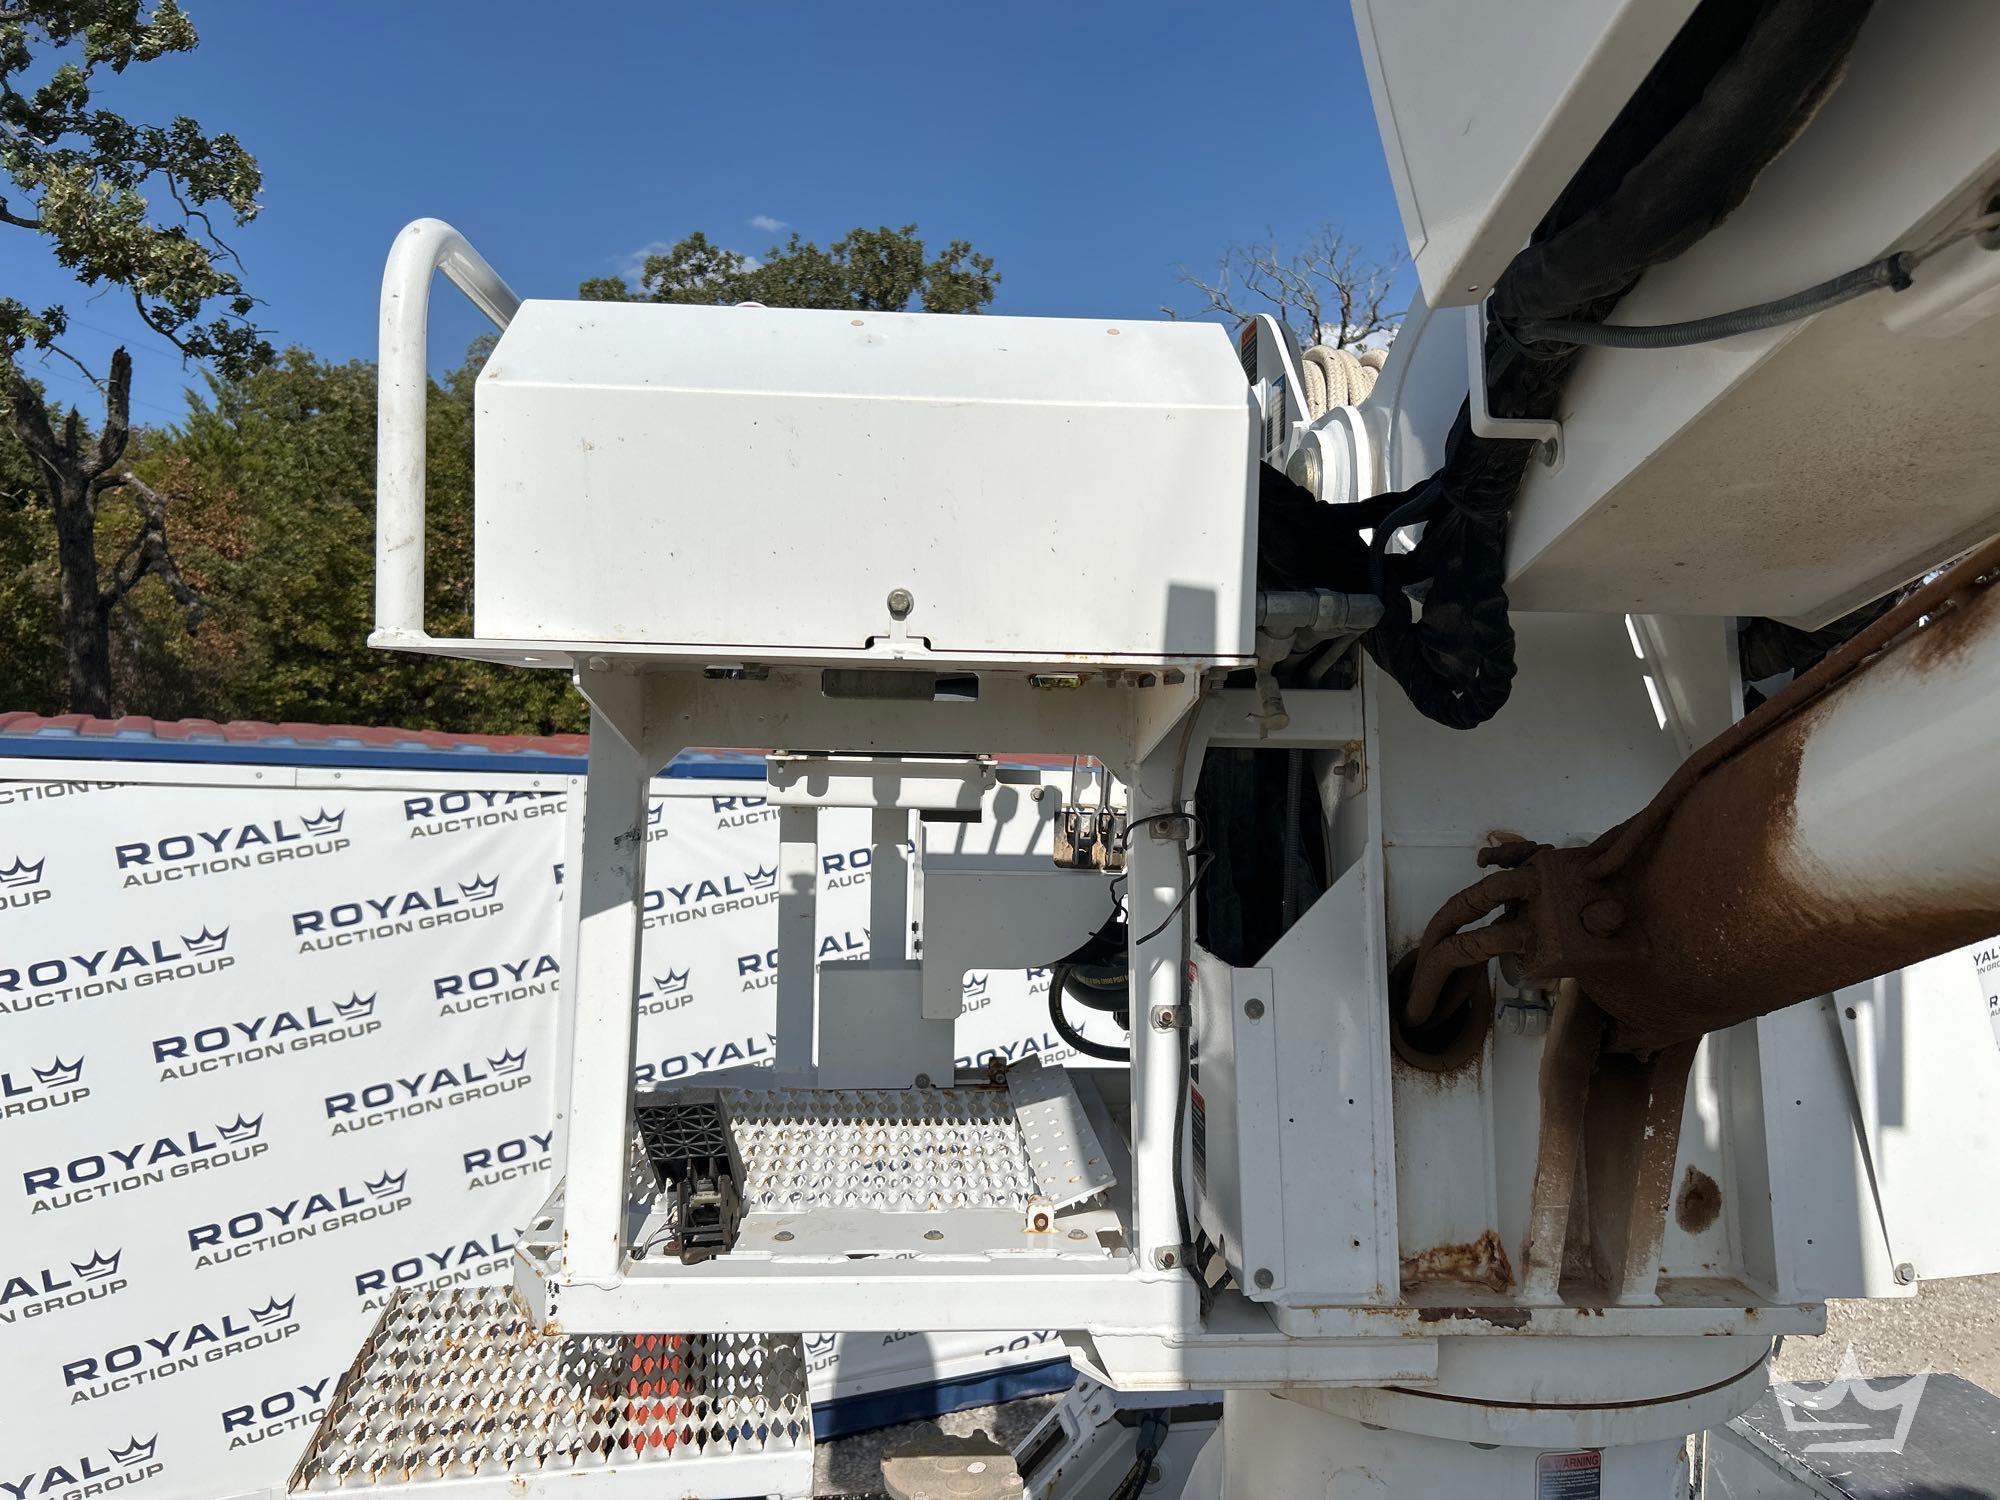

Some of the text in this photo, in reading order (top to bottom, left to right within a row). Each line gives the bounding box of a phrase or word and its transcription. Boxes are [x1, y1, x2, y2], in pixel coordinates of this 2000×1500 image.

[0, 780, 89, 804] CTION
[410, 801, 567, 838] AUCTION GRO
[717, 808, 780, 830] AUCTI
[115, 820, 301, 869] ROYAL
[123, 838, 351, 888] AUCTION GROUP
[292, 887, 459, 935] ROYAL
[644, 875, 745, 912] OYAL
[299, 902, 504, 954] AUCTION GROUP
[642, 907, 707, 930] CTION
[0, 940, 182, 992] ROYAL
[434, 954, 560, 999] ROYA
[1973, 948, 1999, 966] YAL
[0, 956, 236, 1014] AUCTION GROUP
[440, 982, 546, 1016] AUCTION
[638, 994, 694, 1016] ROUP
[153, 1006, 334, 1063] ROYAL
[160, 1020, 382, 1082] AUCTION GROUP
[635, 1038, 767, 1085] ROYAL
[0, 1087, 91, 1119] ROUP
[324, 1062, 488, 1118] ROYAL
[331, 1075, 532, 1136] AUCTION GROUP
[23, 1130, 217, 1196] ROYAL
[463, 1131, 553, 1173] ROY
[469, 1157, 552, 1190] AUCTIO
[31, 1142, 269, 1215] AUCTION GROUP
[188, 1187, 365, 1252] ROYAL
[195, 1197, 412, 1270] AUCTION GROUP
[355, 1233, 515, 1295] ROYAL
[23, 1278, 128, 1319] GROUP
[63, 1315, 249, 1387] ROYAL
[70, 1323, 300, 1405] AUCTION GROUP
[221, 1371, 349, 1433] ROY
[228, 1407, 327, 1451] AUCTIO
[0, 1456, 110, 1500] YAL
[62, 1462, 164, 1500] GROUP
